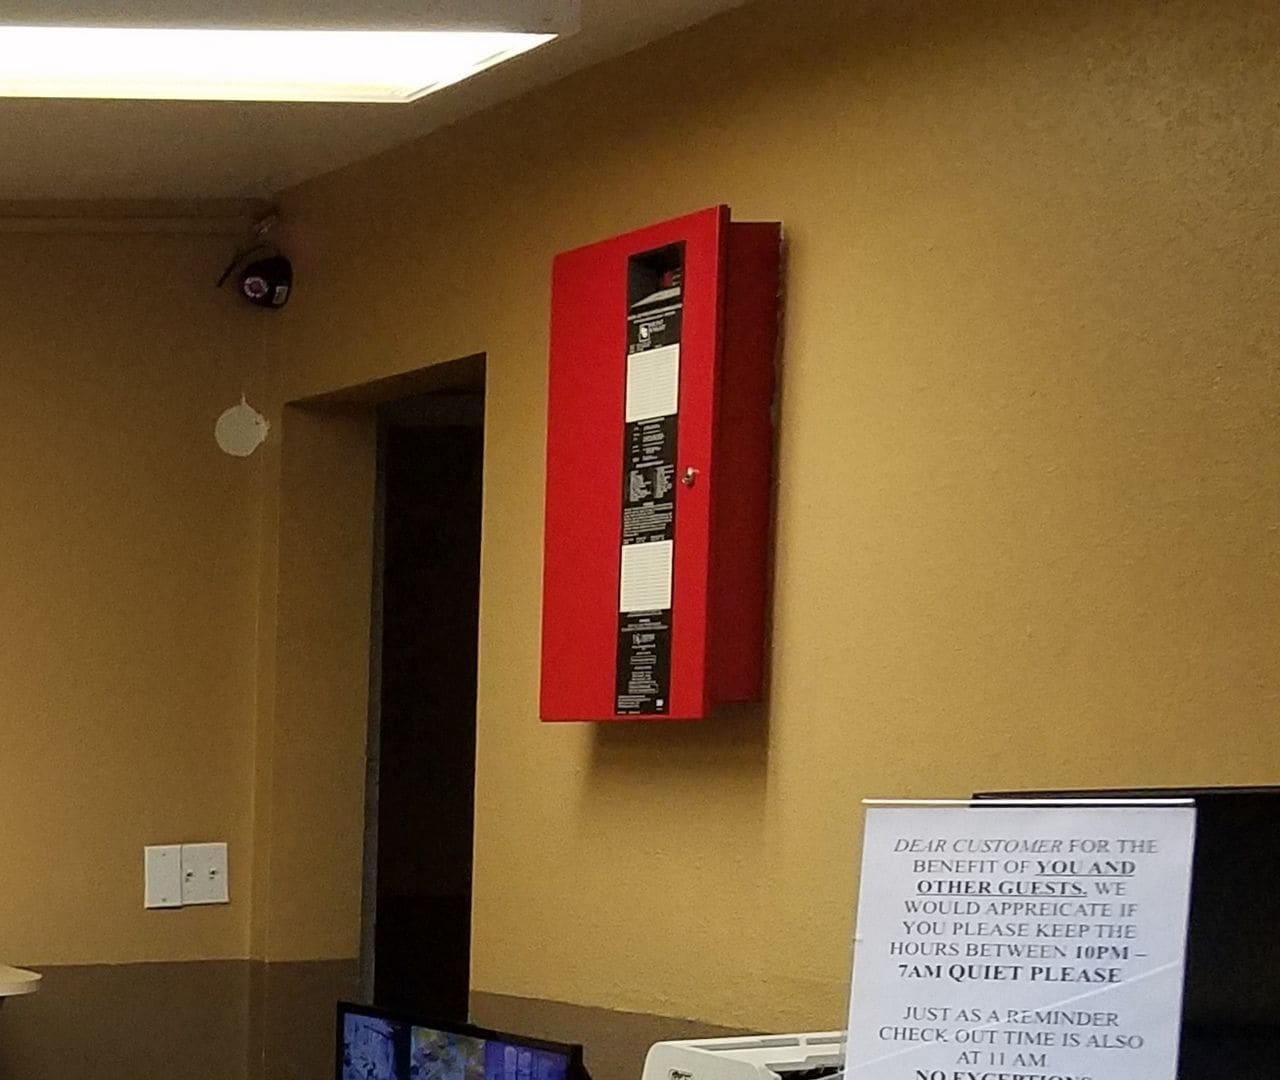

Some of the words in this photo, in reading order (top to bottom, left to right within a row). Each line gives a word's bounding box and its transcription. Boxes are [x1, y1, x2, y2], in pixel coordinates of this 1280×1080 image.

[894, 838, 946, 853] DEAR
[953, 838, 1063, 854] CUSTOMER
[1069, 839, 1109, 853] FOR
[1117, 839, 1159, 854] THE
[913, 859, 998, 874] BENEFIT
[1004, 860, 1029, 874] OF
[1036, 860, 1082, 876] YOU
[1090, 861, 1136, 877] AND
[916, 880, 992, 896] OTHER
[998, 880, 1088, 897] GUESTS.
[1095, 881, 1127, 897] WE
[904, 901, 980, 916] WOULD
[989, 902, 1112, 918] APPREICATE
[1120, 903, 1138, 917] IF
[903, 921, 945, 936] YOU
[953, 922, 1029, 938] PLEASE
[1036, 923, 1090, 938] KEEP
[1094, 925, 1138, 939] THE
[889, 941, 959, 957] HOURS
[966, 943, 1067, 959] BETWEEN
[1075, 945, 1130, 961] 10PM
[898, 963, 942, 980] 7AM
[948, 964, 1023, 982] QUIET
[1030, 966, 1122, 984] PLEASE
[902, 1007, 951, 1022] JUST
[957, 1009, 981, 1023] AS
[988, 1010, 1002, 1024] A
[1007, 1010, 1119, 1027] REMINDER
[879, 1026, 948, 1043] CHECK
[955, 1029, 999, 1044] OUT
[1003, 1031, 1055, 1047] TIME
[1062, 1033, 1080, 1047] IS
[1089, 1033, 1144, 1049] ALSO
[956, 1051, 980, 1065] AT
[989, 1052, 1005, 1066] 11
[1012, 1053, 1046, 1068] AM
